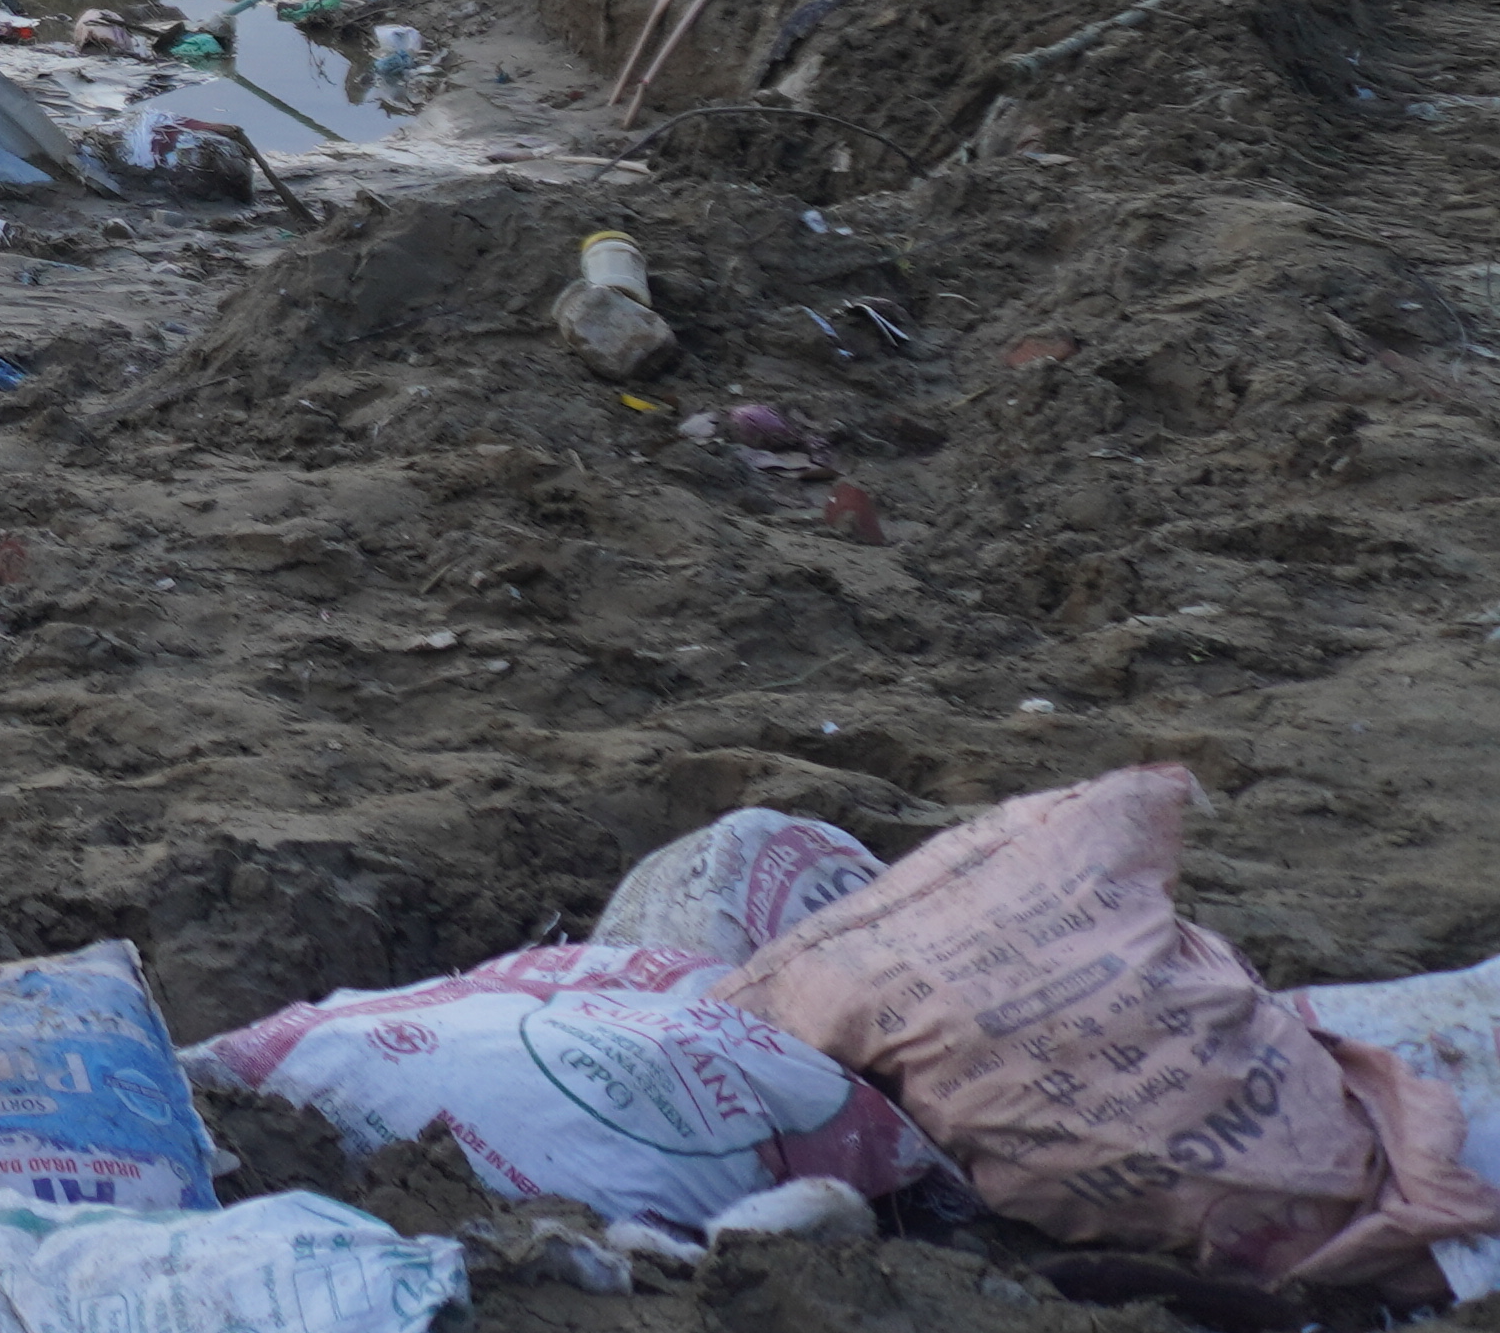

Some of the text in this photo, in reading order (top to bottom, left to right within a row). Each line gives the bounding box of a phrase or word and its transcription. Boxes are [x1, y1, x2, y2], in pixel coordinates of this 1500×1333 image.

[560, 1048, 634, 1111] (PPC)
[572, 1000, 749, 1121] RAJDHANI
[637, 1074, 696, 1138] CEMENT
[1051, 1044, 1290, 1205] HONGSHI
[29, 1157, 78, 1175] URAD
[434, 1108, 488, 1155] MADE
[485, 1149, 508, 1171] IN
[503, 1164, 541, 1197] NEP
